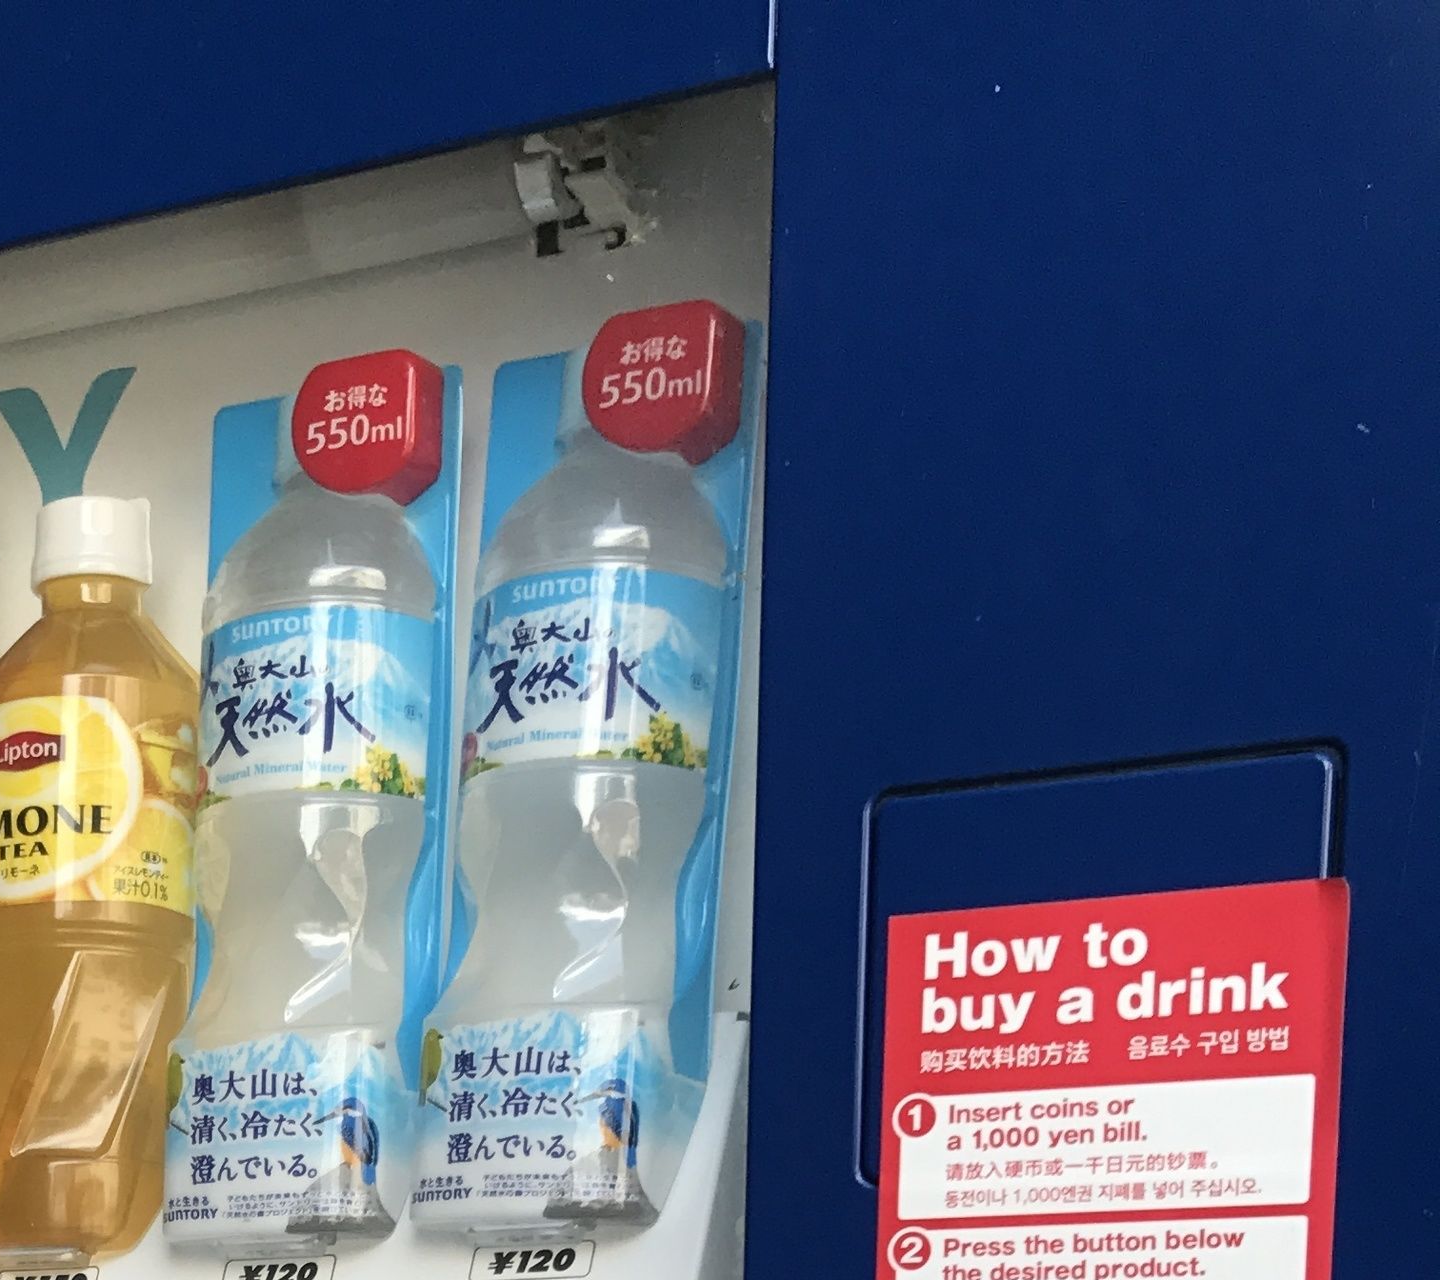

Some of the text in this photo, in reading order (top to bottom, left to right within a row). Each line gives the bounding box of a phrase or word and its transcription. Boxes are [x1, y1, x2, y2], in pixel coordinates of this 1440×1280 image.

[620, 337, 687, 363] お得な
[599, 365, 704, 409] 550ml
[209, 684, 374, 767] 天然水
[1, 865, 40, 879] リモーネ
[924, 923, 1147, 980] How to
[921, 962, 1288, 1034] buy a drink
[920, 1041, 1090, 1073] 购买饮料的方法
[1128, 1027, 1289, 1060] 음료수 구입 방법
[452, 1046, 581, 1081] 奥大山は、
[449, 1089, 583, 1122] 清く、冷たく、
[909, 1105, 922, 1130] 1
[949, 1098, 1134, 1125] Insert coins or
[448, 1135, 576, 1164] 澄んでいる。
[947, 1122, 1147, 1151] a 1,000 yen bill.
[899, 1239, 923, 1265] 2
[943, 1230, 1244, 1258] Press the button below
[488, 1248, 576, 1274] ¥120
[991, 1262, 1086, 1280] desired
[1094, 1258, 1206, 1280] product.
